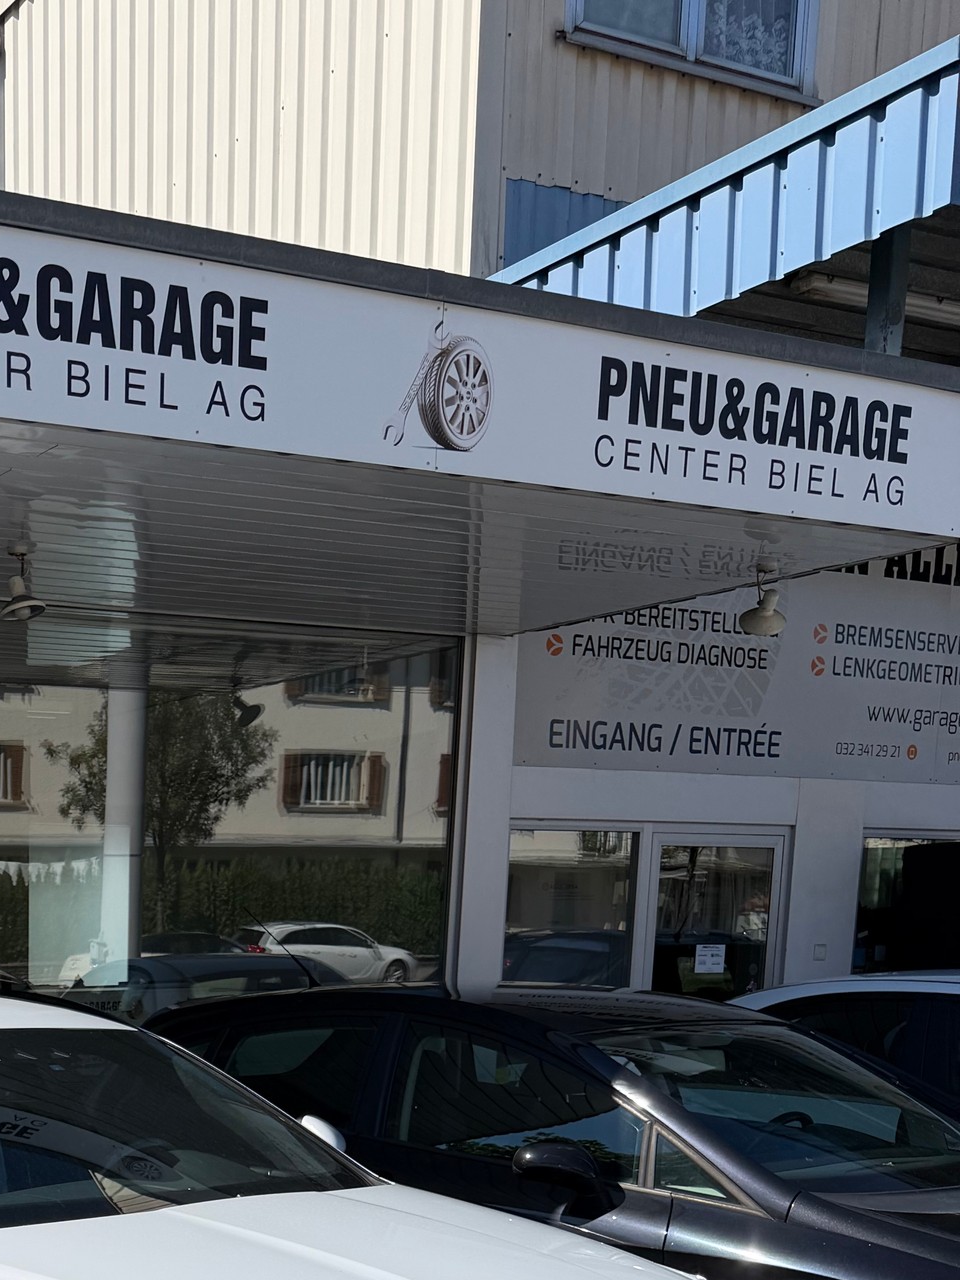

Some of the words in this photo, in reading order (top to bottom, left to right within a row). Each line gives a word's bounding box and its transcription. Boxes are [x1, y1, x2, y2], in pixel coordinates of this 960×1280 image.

[67, 360, 179, 411] BIEL
[206, 380, 266, 423] AG
[598, 356, 912, 464] PNEU&GARAGE
[594, 434, 747, 485] CENTER
[768, 459, 844, 498] BIEL
[863, 472, 905, 506] AG
[572, 634, 671, 662] FAHRZEUG
[677, 641, 769, 670] DIAGNOSE
[832, 656, 960, 686] LENKGEOMETRI
[548, 719, 663, 752] EINGANG
[669, 724, 682, 756] /
[690, 723, 782, 758] ENTRÉE
[867, 705, 960, 735] www.garag
[835, 742, 855, 756] 032
[858, 744, 874, 757] 341
[876, 744, 888, 758] 29
[890, 745, 901, 758] 21
